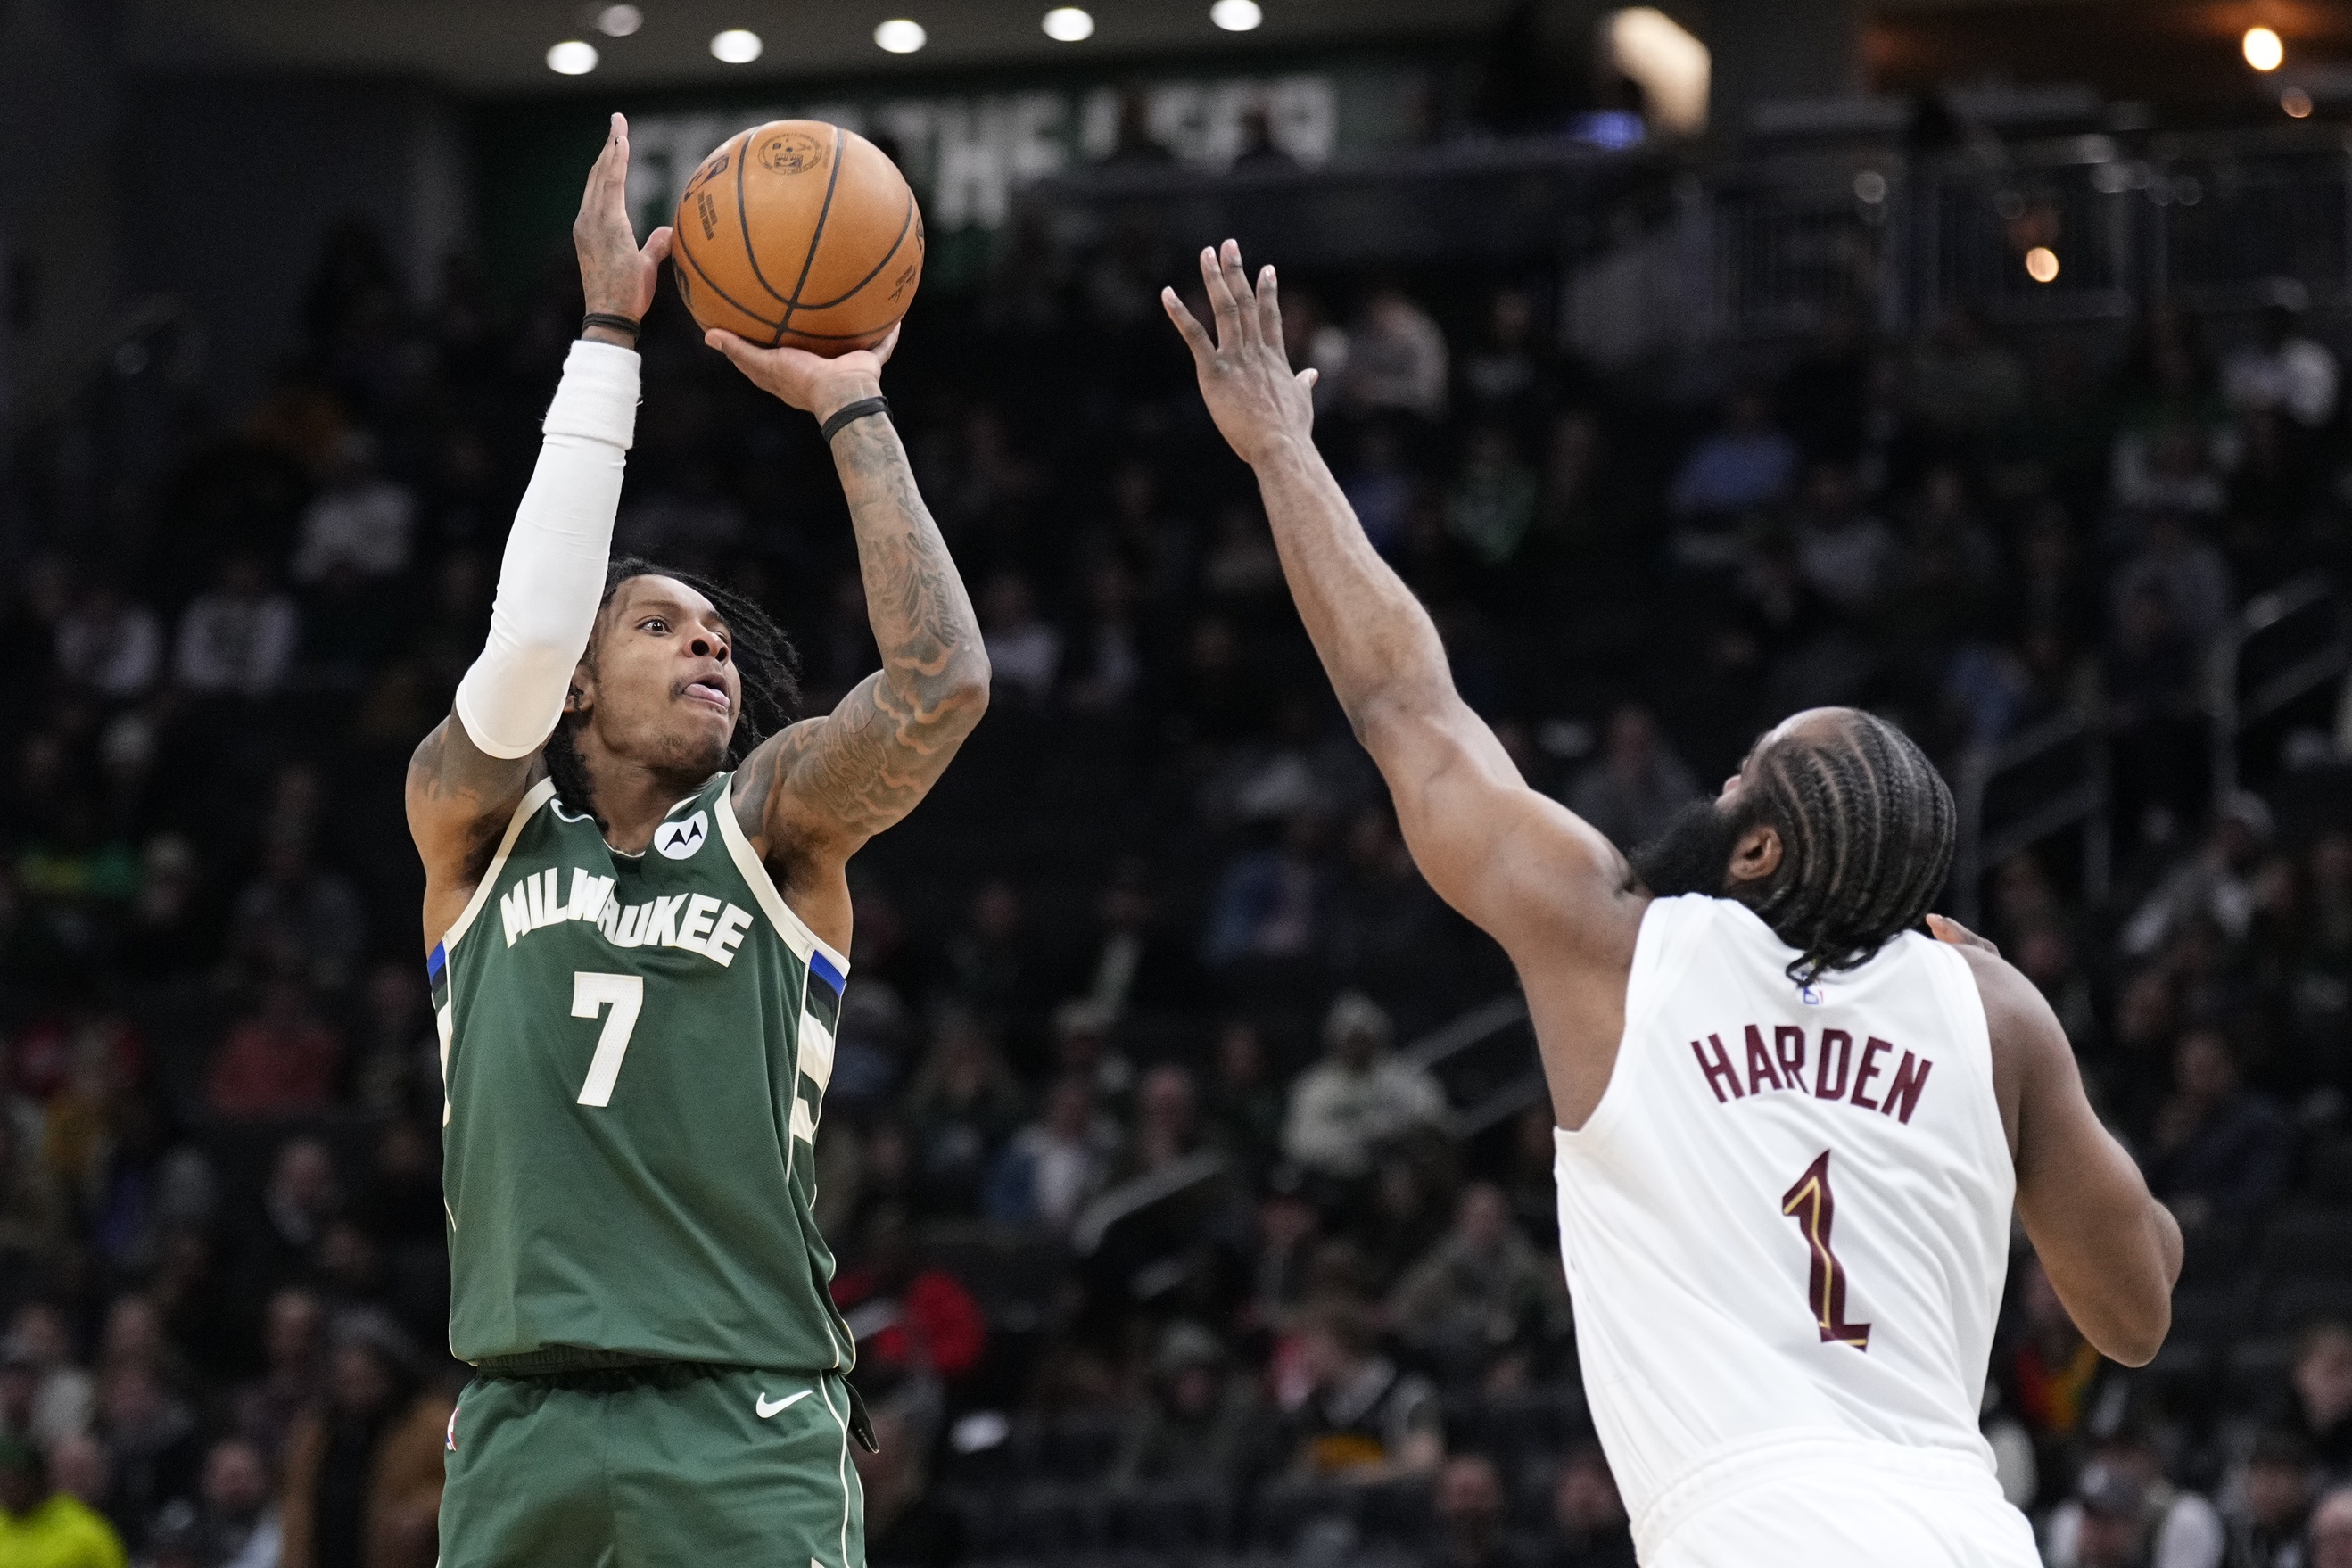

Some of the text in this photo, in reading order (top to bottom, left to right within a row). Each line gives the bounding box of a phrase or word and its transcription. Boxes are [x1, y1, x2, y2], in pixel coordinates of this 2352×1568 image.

[499, 866, 754, 968] MILWAUKEE
[571, 971, 644, 1107] 7
[1690, 1023, 1933, 1126] HARDEN
[1781, 1148, 1872, 1353] 1
